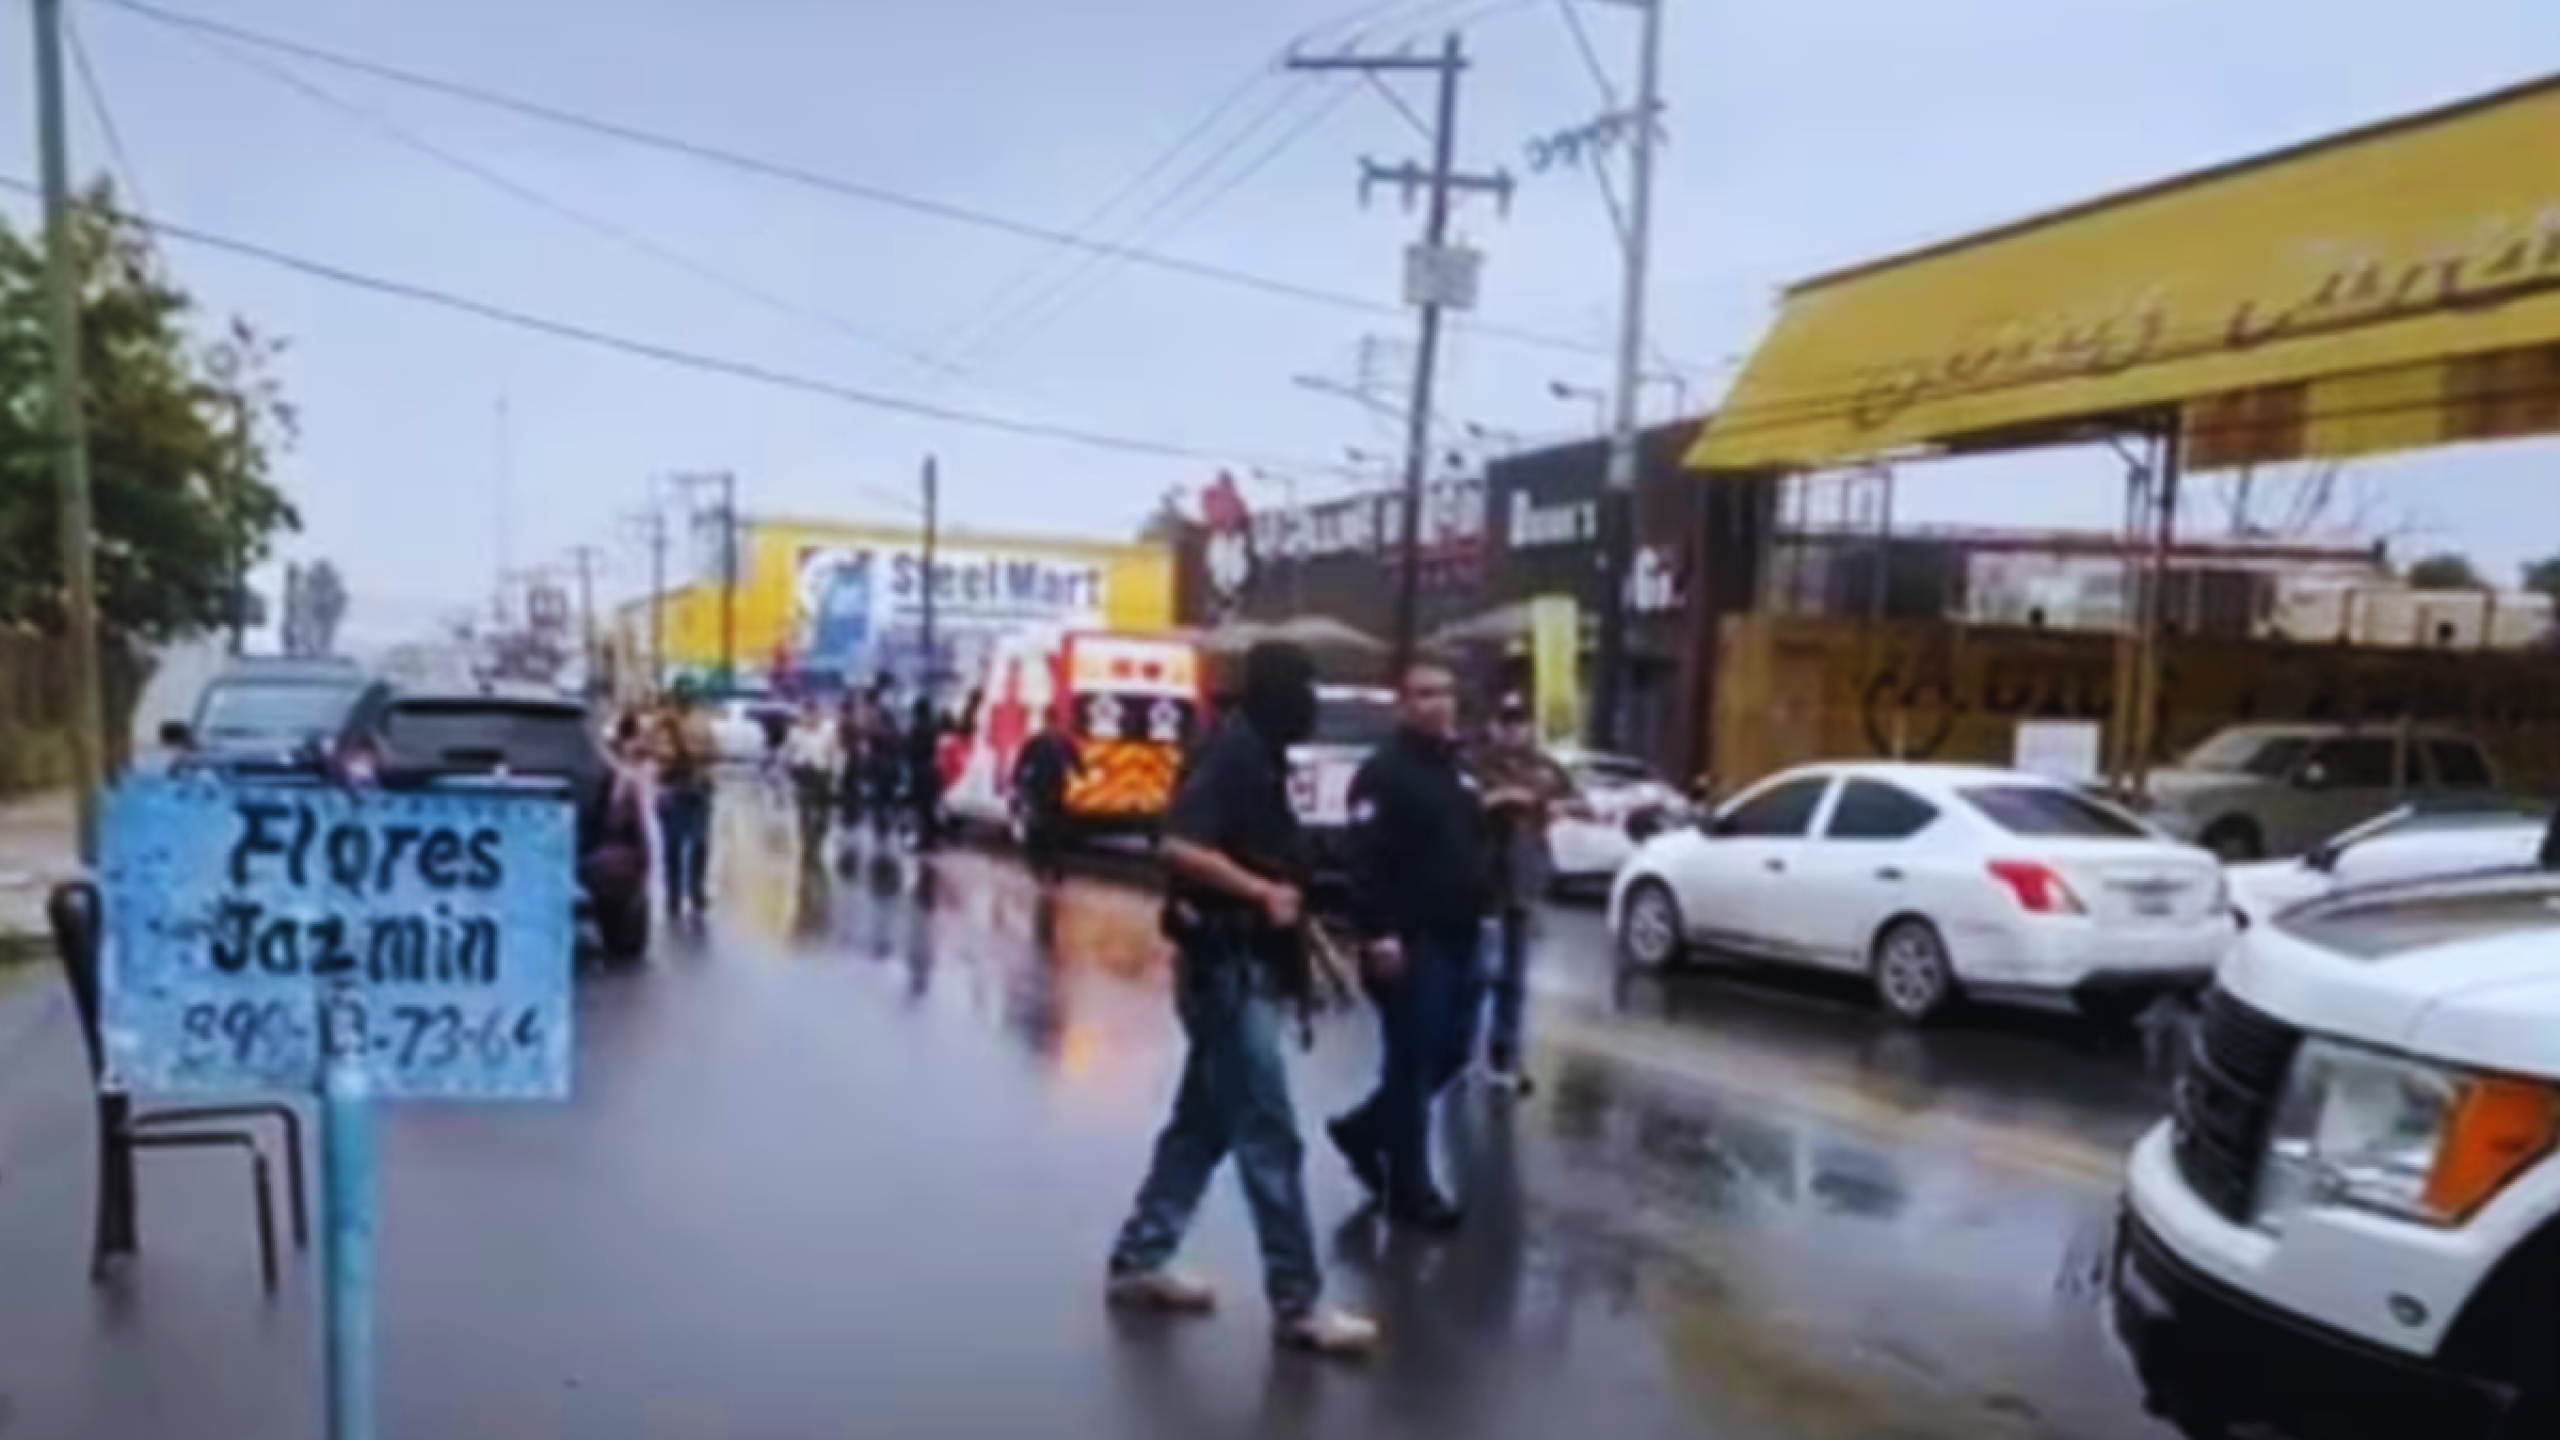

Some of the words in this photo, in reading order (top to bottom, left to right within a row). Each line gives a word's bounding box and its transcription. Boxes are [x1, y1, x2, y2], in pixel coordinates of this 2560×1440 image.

[1006, 560, 1103, 609] Mart
[229, 801, 504, 898] Flores
[211, 899, 499, 985] Jazmin
